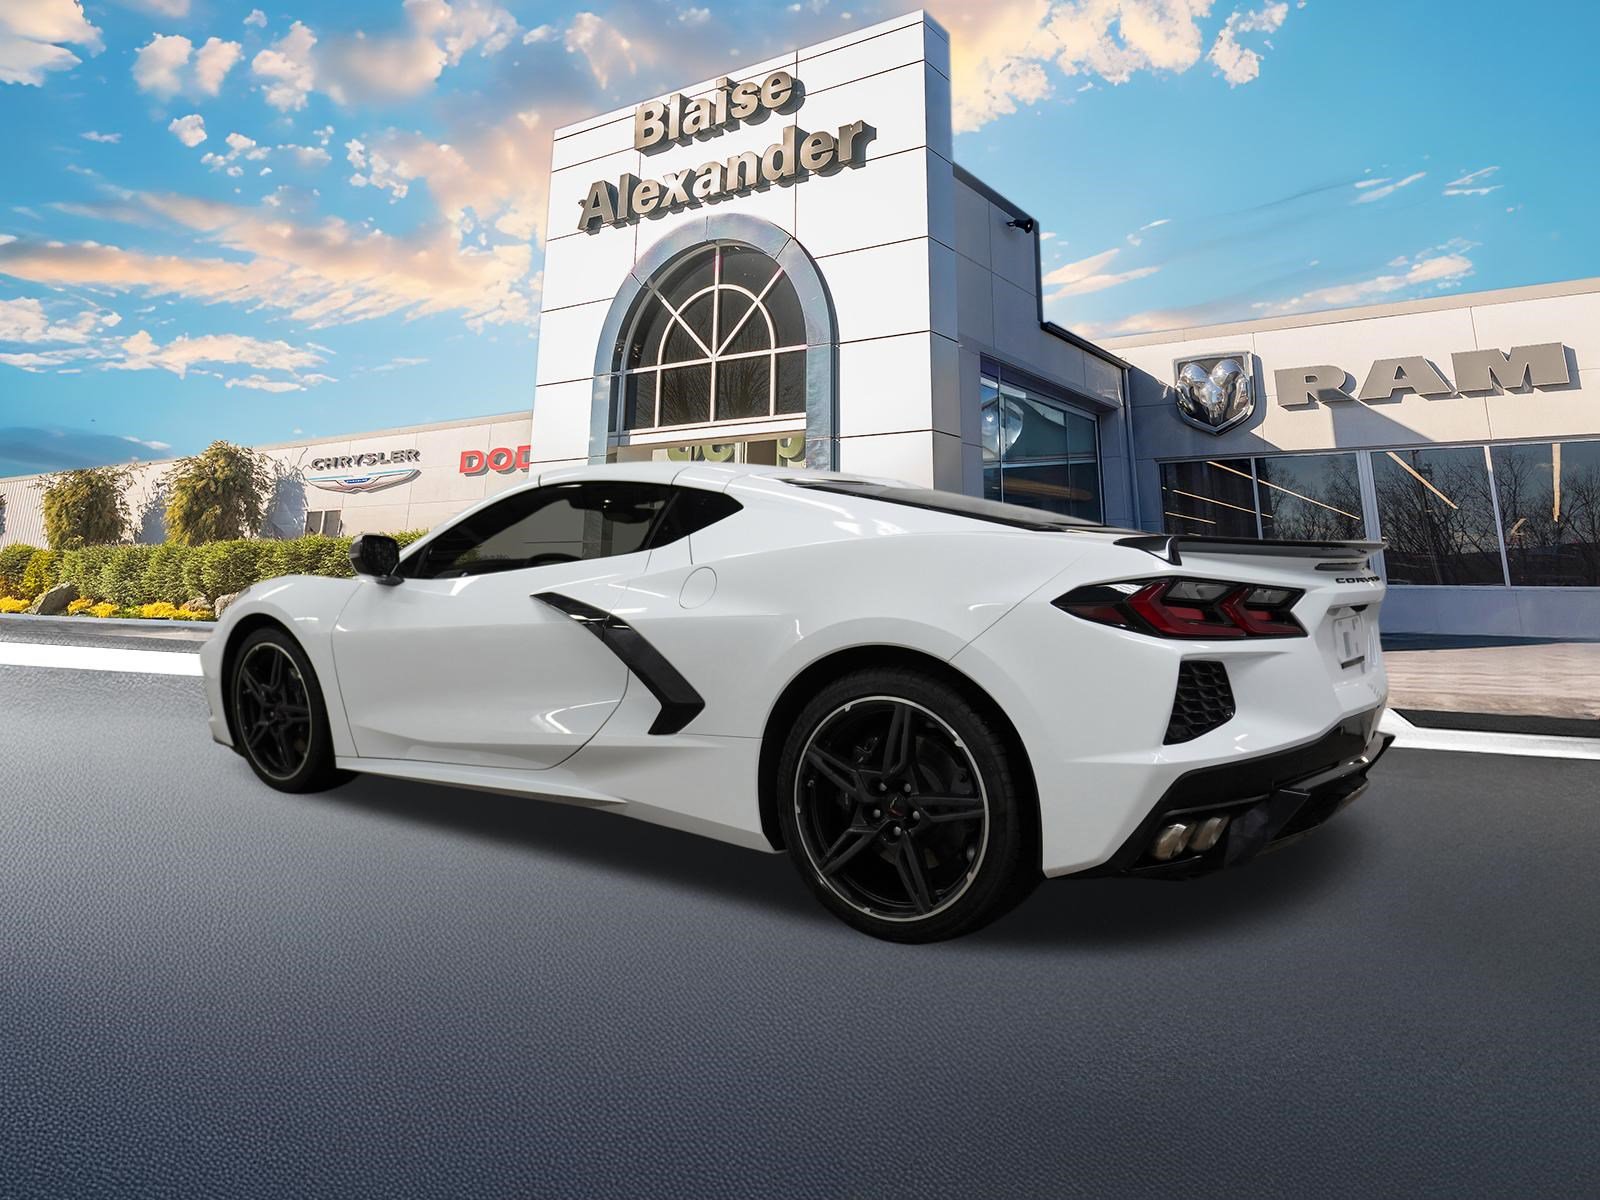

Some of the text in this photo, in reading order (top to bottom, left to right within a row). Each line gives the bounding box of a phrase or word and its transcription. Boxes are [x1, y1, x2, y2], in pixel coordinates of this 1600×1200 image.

[634, 71, 801, 155] Blaise
[577, 119, 874, 233] Alexander
[1274, 342, 1574, 406] RAM
[311, 448, 420, 471] CHRYSLER
